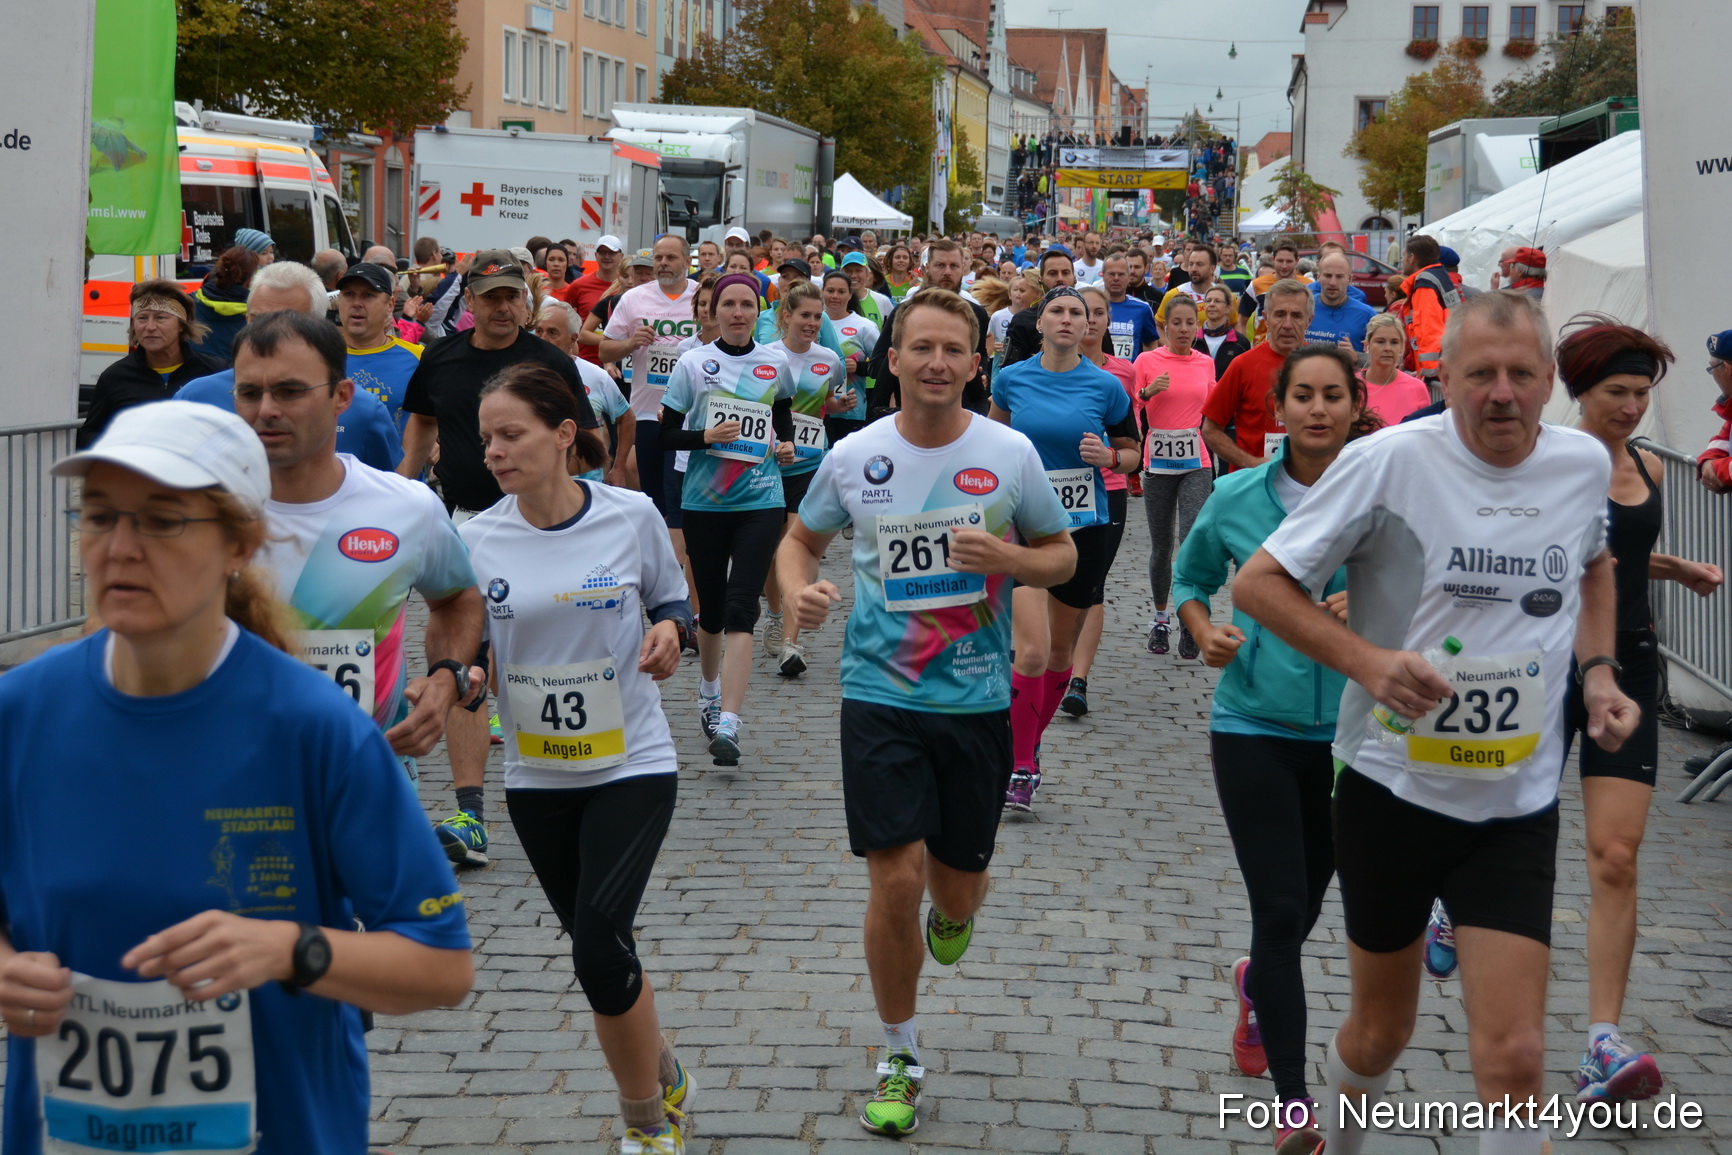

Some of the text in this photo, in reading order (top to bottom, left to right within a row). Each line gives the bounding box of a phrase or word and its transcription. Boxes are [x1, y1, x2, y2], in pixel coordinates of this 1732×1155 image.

[632, 142, 691, 157] OCK
[1098, 174, 1143, 185] START
[500, 184, 564, 196] Bayerisches
[500, 197, 530, 207] Rotes
[193, 210, 224, 229] Bayerisches
[499, 210, 529, 220] Kreuz
[836, 216, 878, 226] Laufsport
[195, 228, 211, 244] Rotes
[1116, 344, 1131, 357] 75
[756, 368, 775, 376] Hervis
[710, 402, 764, 415] PARTL Neumarkt
[720, 442, 753, 454] Wencke
[1154, 439, 1195, 458] 2131
[1166, 460, 1184, 468] Luise
[960, 474, 994, 489] Hervis
[1048, 475, 1082, 483] Neumarkt
[862, 489, 893, 498] PARTL
[1476, 507, 1540, 517] orca
[879, 517, 965, 534] PARTL Neumarkt
[348, 536, 393, 554] Hervis
[1446, 546, 1537, 577] Allianz
[906, 578, 968, 597] Christian
[553, 592, 574, 603] 14.
[490, 605, 514, 614] PARTL
[956, 641, 976, 656] 16.
[952, 652, 999, 666] Neumarkter
[952, 664, 992, 677] Stadtlauf
[1456, 668, 1521, 682] Neumarkt
[312, 663, 361, 704] 6
[507, 672, 598, 687] PARTL Neumarkt
[541, 691, 587, 730] 43
[1434, 686, 1520, 734] 232
[543, 740, 592, 759] Angela
[1450, 746, 1504, 767] Georg
[205, 806, 294, 820] NEUMARKTER
[102, 996, 206, 1020] Neumarkt
[58, 1018, 232, 1098] 2075
[86, 1114, 197, 1150] Dagmar
